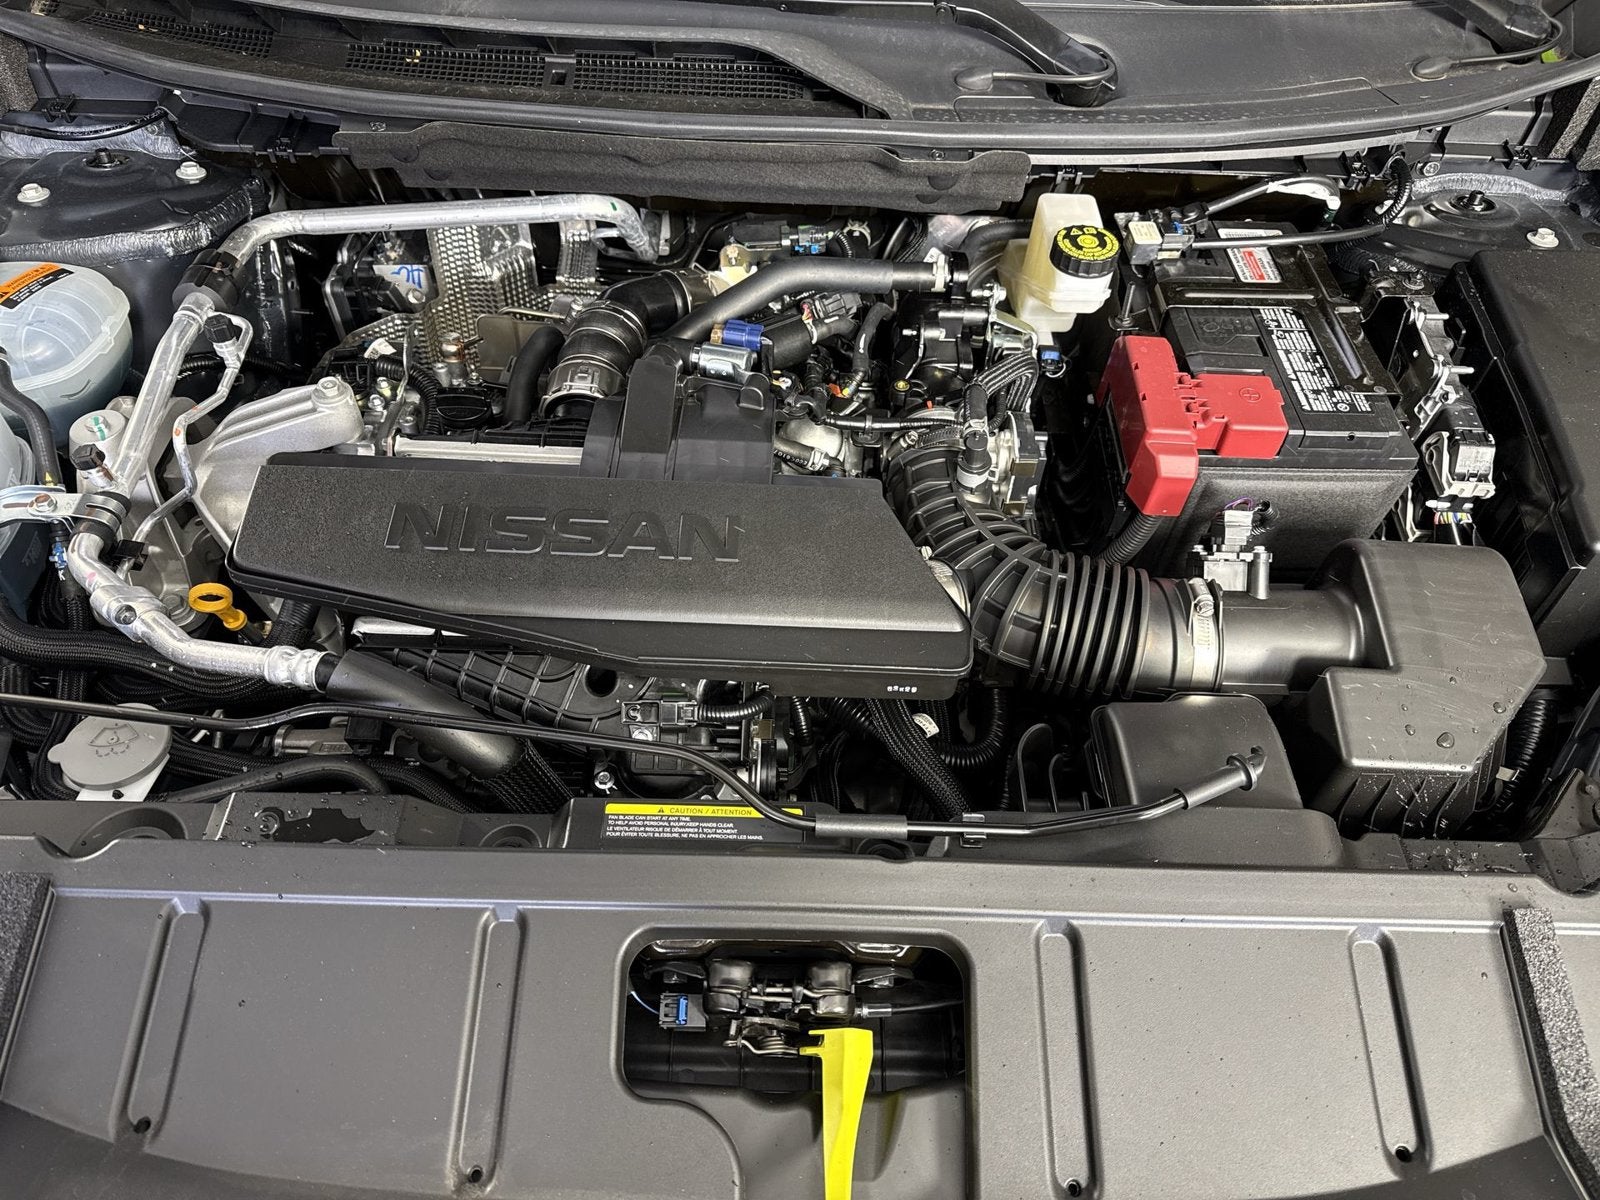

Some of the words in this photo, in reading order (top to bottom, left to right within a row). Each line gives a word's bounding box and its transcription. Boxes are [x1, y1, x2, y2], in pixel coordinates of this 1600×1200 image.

[384, 502, 740, 563] NISSAN
[669, 807, 703, 815] CAUTION
[711, 808, 752, 816] ATTENTION
